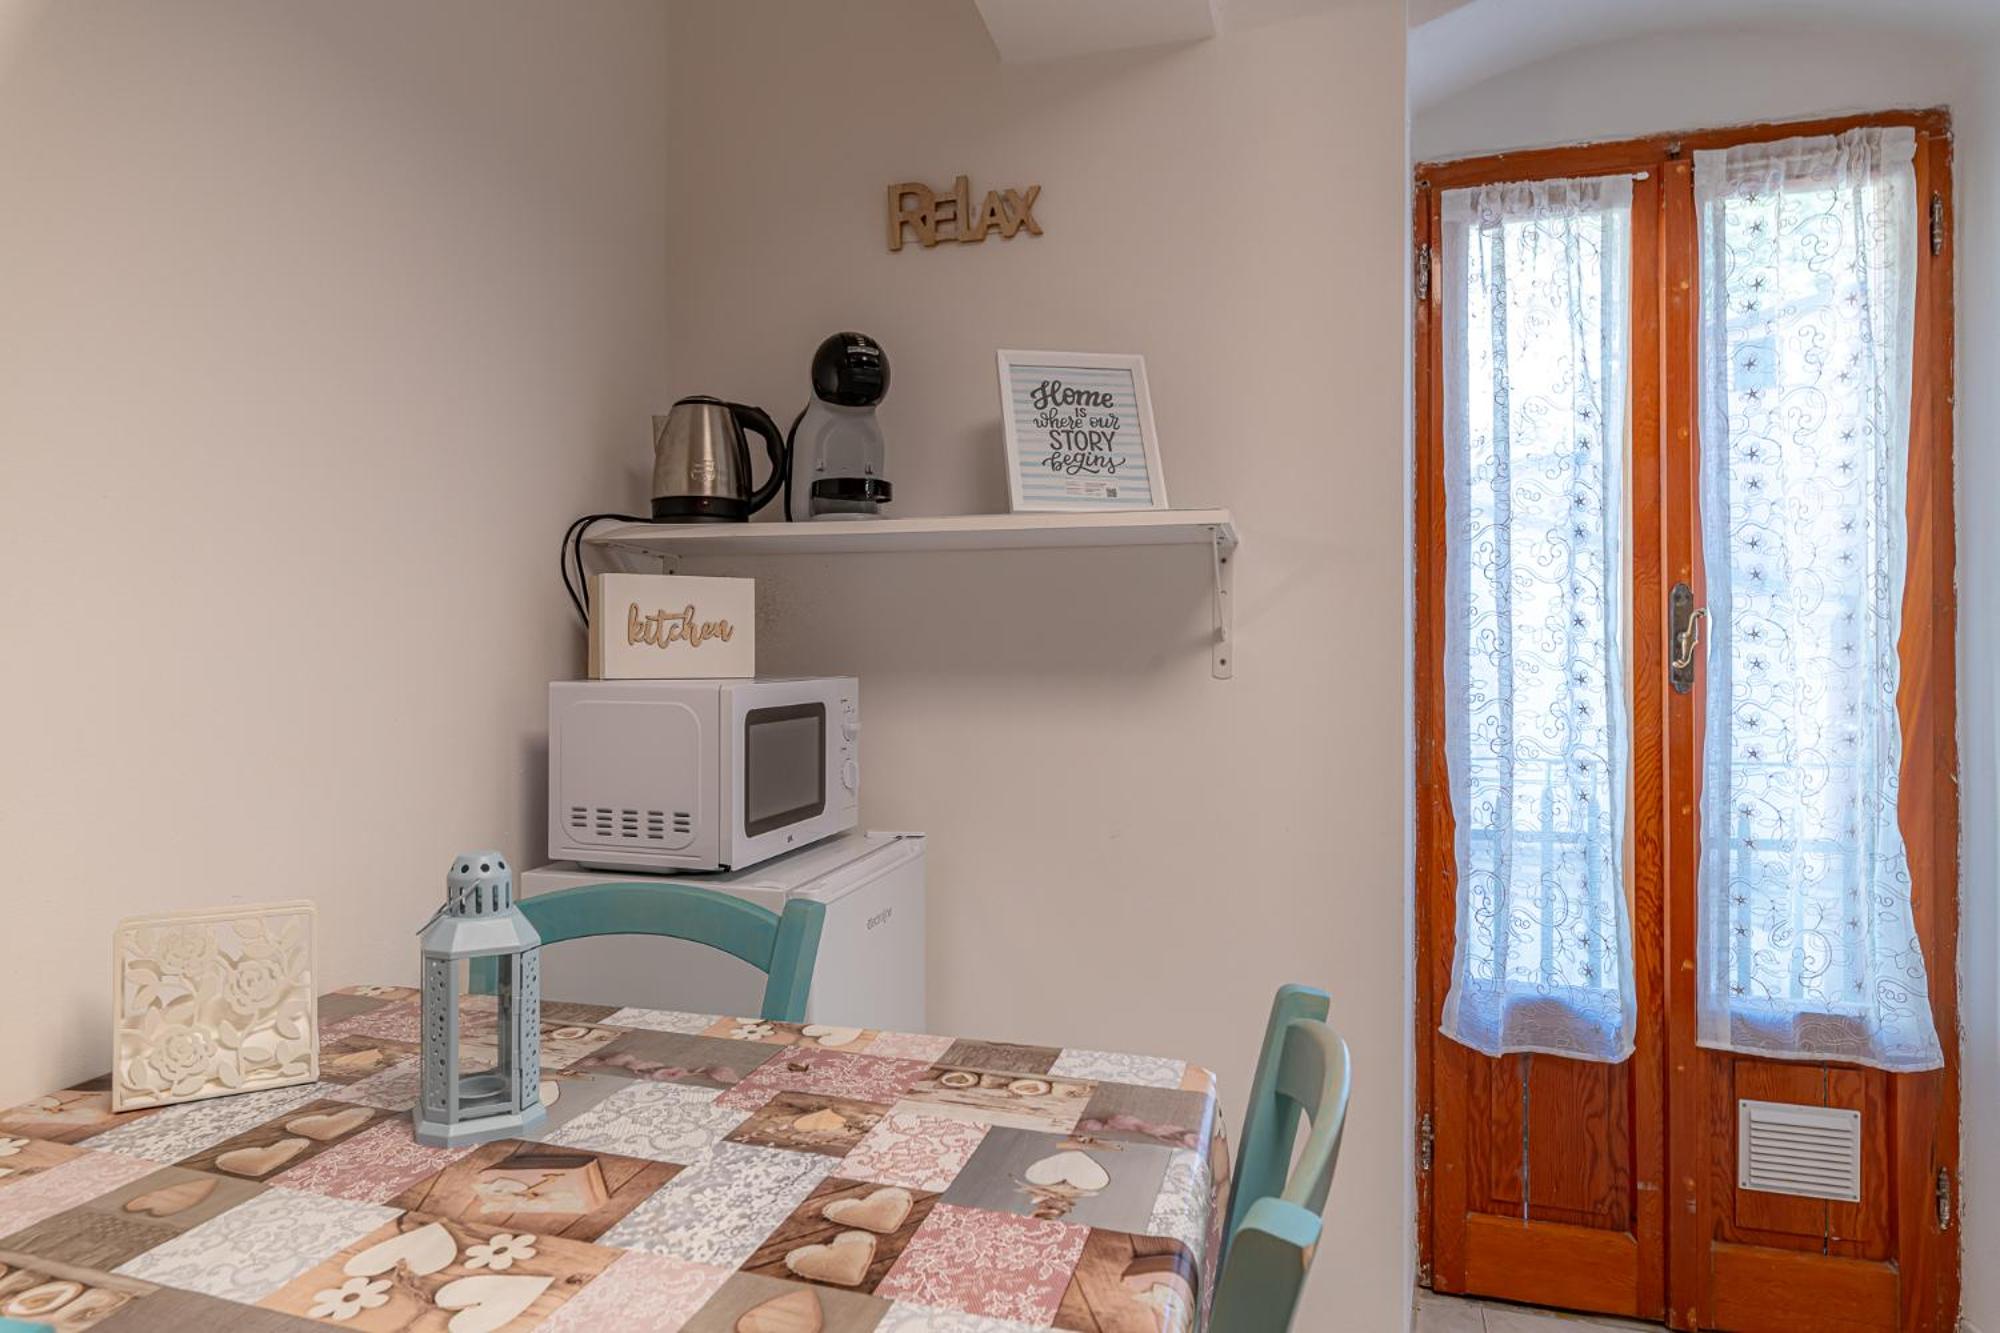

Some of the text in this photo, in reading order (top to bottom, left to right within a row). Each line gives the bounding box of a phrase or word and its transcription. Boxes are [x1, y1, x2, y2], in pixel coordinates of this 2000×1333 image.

[1030, 380, 1114, 410] Home
[1033, 407, 1121, 430] where our
[1049, 430, 1115, 452] STORY
[1041, 452, 1126, 475] begins
[627, 602, 736, 649] kitchen
